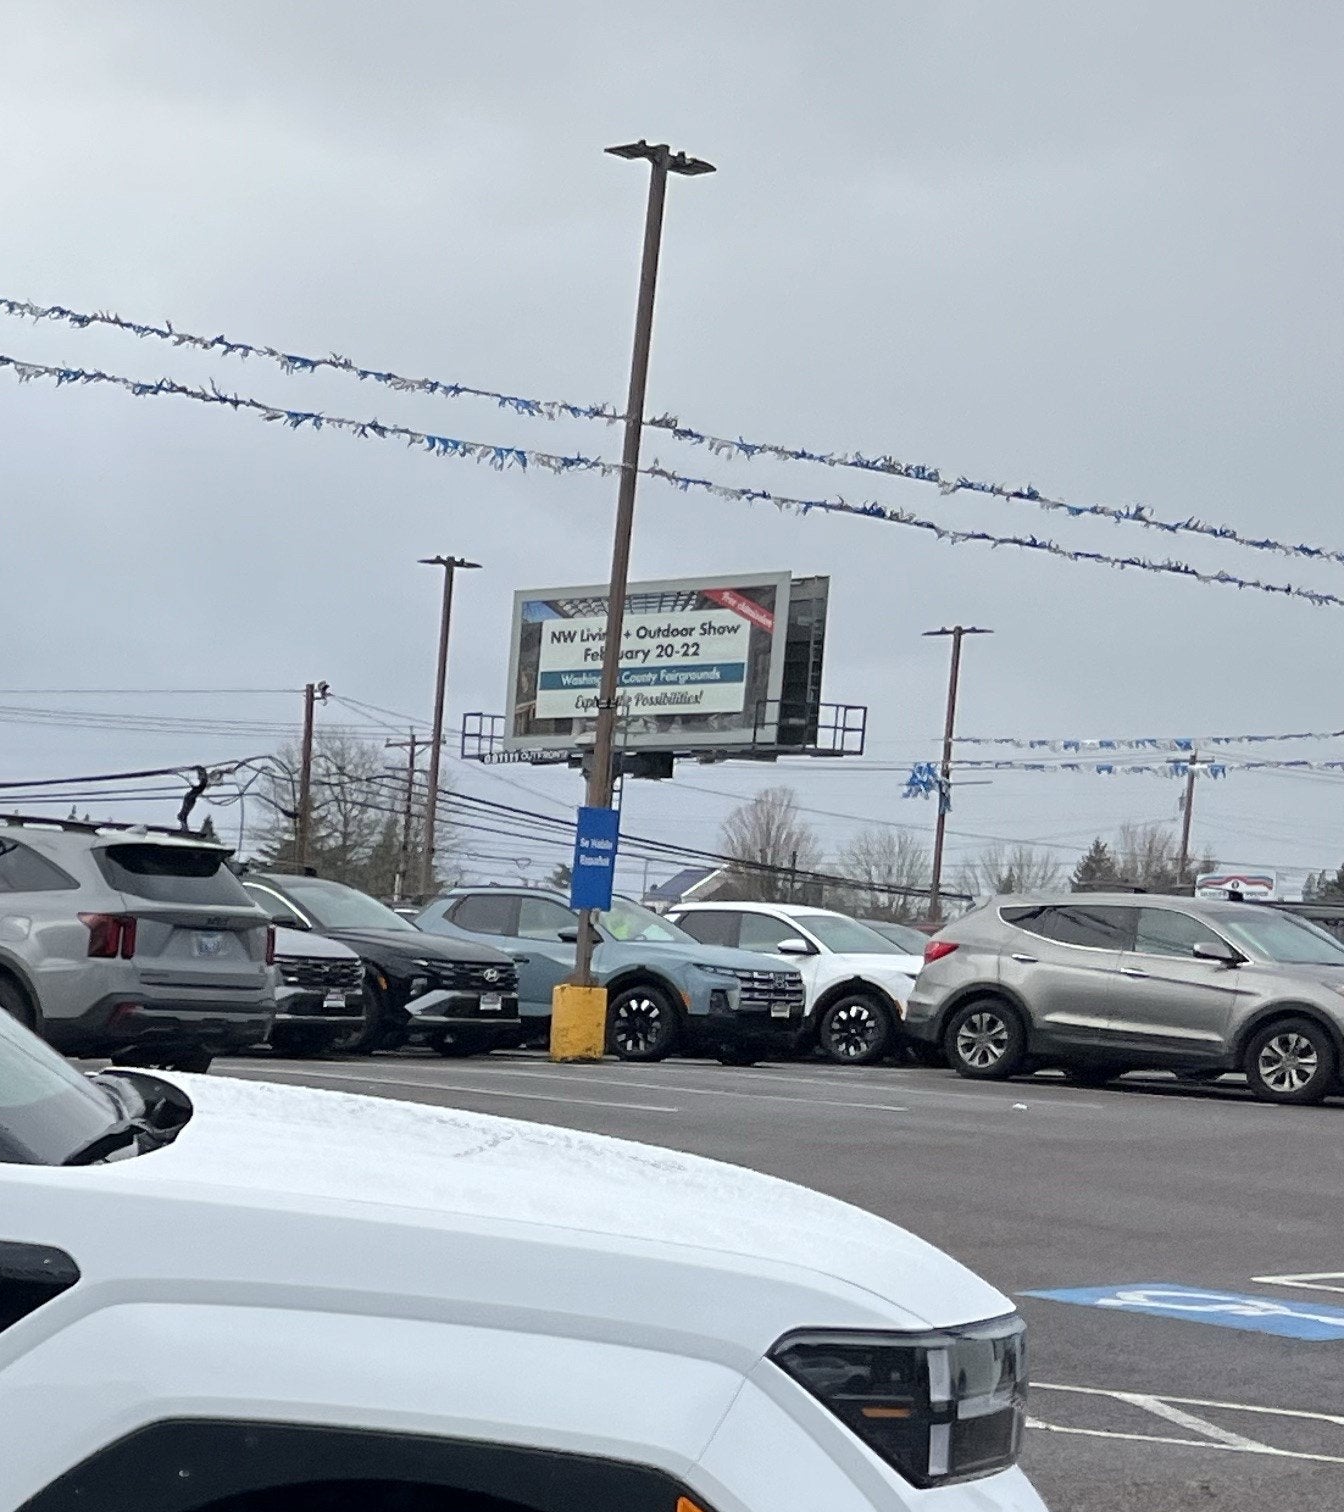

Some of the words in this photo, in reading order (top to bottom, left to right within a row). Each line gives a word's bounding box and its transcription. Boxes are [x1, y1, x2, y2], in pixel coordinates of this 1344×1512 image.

[550, 630, 578, 644] NW
[636, 623, 696, 640] Outdoor
[699, 620, 741, 636] Show
[655, 641, 700, 658] 20-22
[622, 670, 657, 686] County
[660, 666, 721, 684] Fairgrounds
[634, 688, 704, 707] Possibilities!
